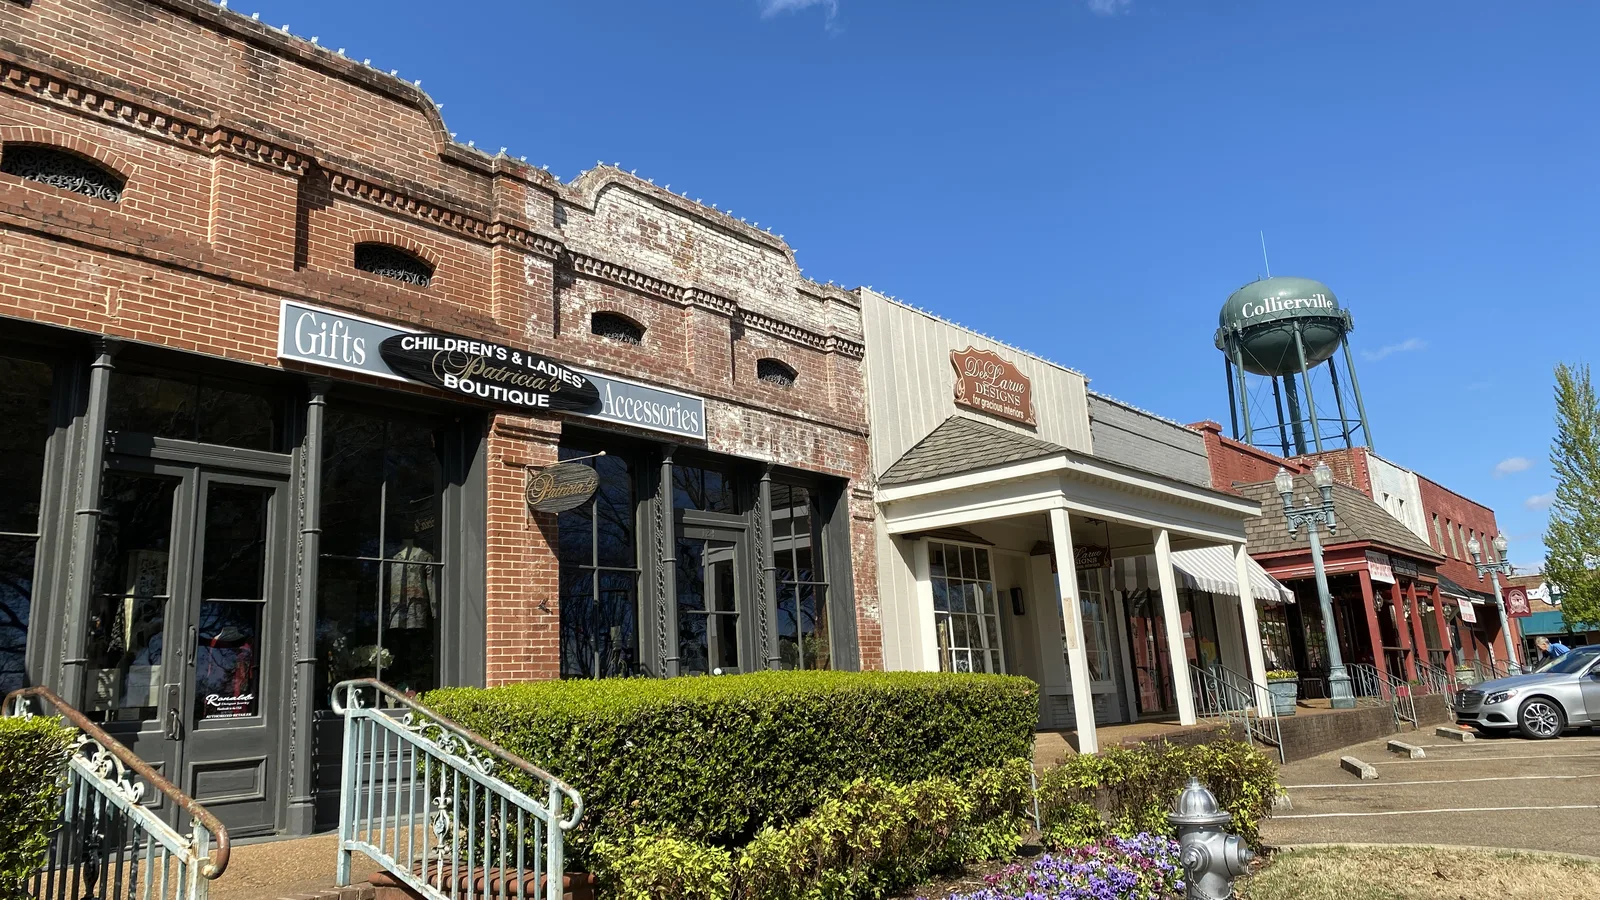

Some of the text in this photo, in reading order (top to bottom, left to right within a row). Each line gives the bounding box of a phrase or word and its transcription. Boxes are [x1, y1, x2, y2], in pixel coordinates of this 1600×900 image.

[1241, 293, 1334, 319] Collierville
[294, 312, 366, 366] Gifts
[400, 336, 586, 389] CHILDREN'S & LADIES'
[431, 349, 562, 393] Patricia's
[443, 373, 550, 408] BOUTIQUE
[600, 382, 699, 433] Accessories
[972, 394, 1024, 419] for gracious interiors
[974, 381, 1021, 407] DESIGNS
[526, 473, 596, 505] Patricia's
